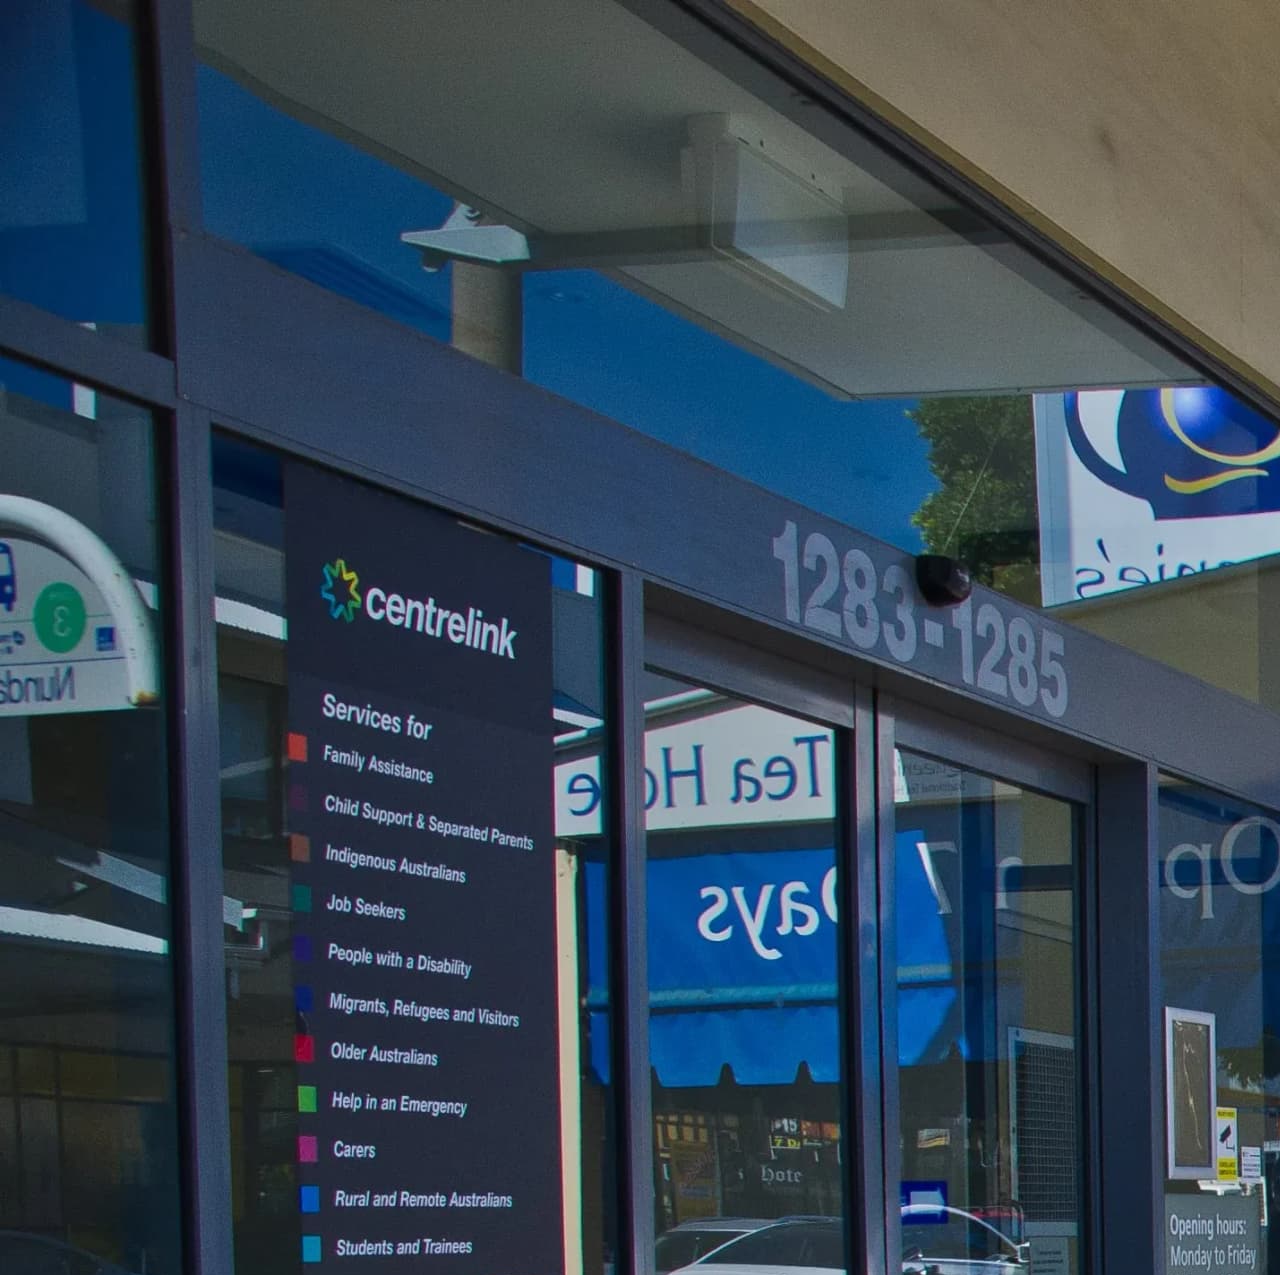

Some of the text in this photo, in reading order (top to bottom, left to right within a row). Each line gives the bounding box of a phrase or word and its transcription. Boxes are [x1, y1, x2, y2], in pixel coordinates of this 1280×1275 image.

[366, 587, 518, 660] centrelink
[322, 693, 433, 741] Services for
[324, 744, 434, 784] Family Assistance
[325, 795, 534, 851] Child Support & Separated Parents
[325, 844, 467, 884] Indigenous Australians
[326, 894, 406, 921] Job Seekers
[328, 943, 472, 980] People with a Disability
[329, 992, 520, 1028] Migrants, Refugees and Visitors
[331, 1042, 439, 1066] Older Australians
[332, 1091, 468, 1118] Help in an Emergency
[333, 1140, 376, 1159] Carers
[335, 1190, 513, 1208] Rural and Remote Australians
[1170, 1214, 1247, 1240] Opening hours:
[336, 1238, 473, 1256] Students and Trainees
[1171, 1244, 1256, 1272] Monday to Friday
